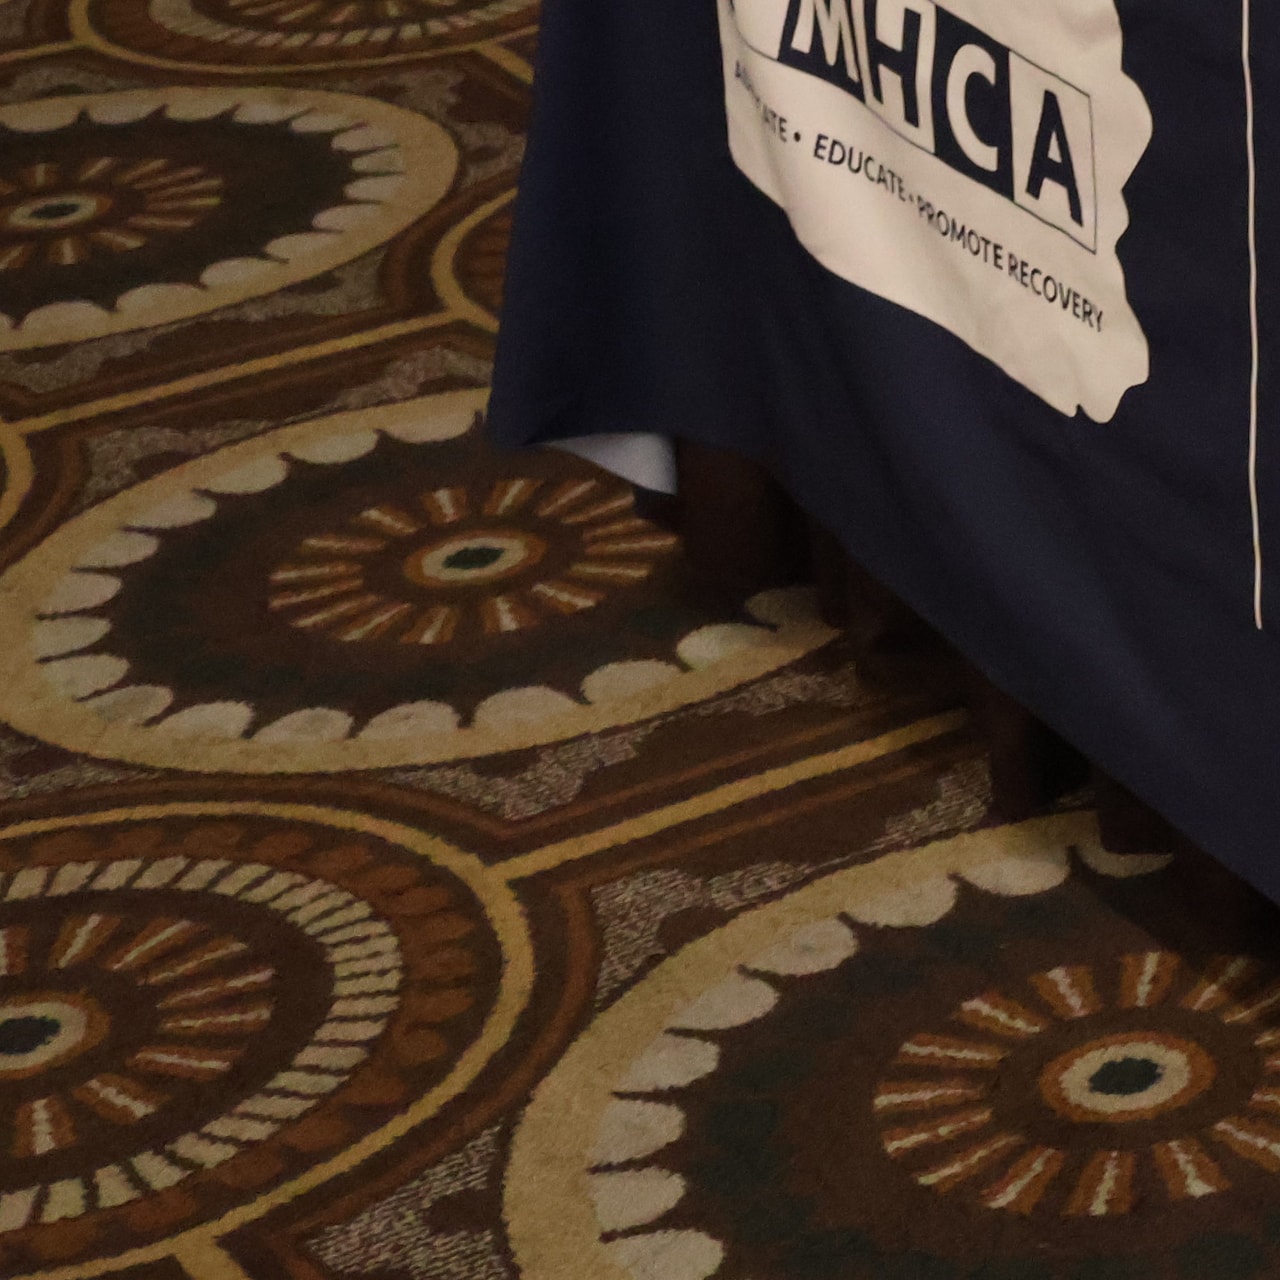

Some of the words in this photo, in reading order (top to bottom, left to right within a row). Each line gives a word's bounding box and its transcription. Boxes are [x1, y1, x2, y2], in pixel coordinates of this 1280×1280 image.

[813, 134, 906, 202] EDUCATE
[917, 195, 1004, 270] PROMOTE
[1008, 253, 1104, 332] RECOVERY
